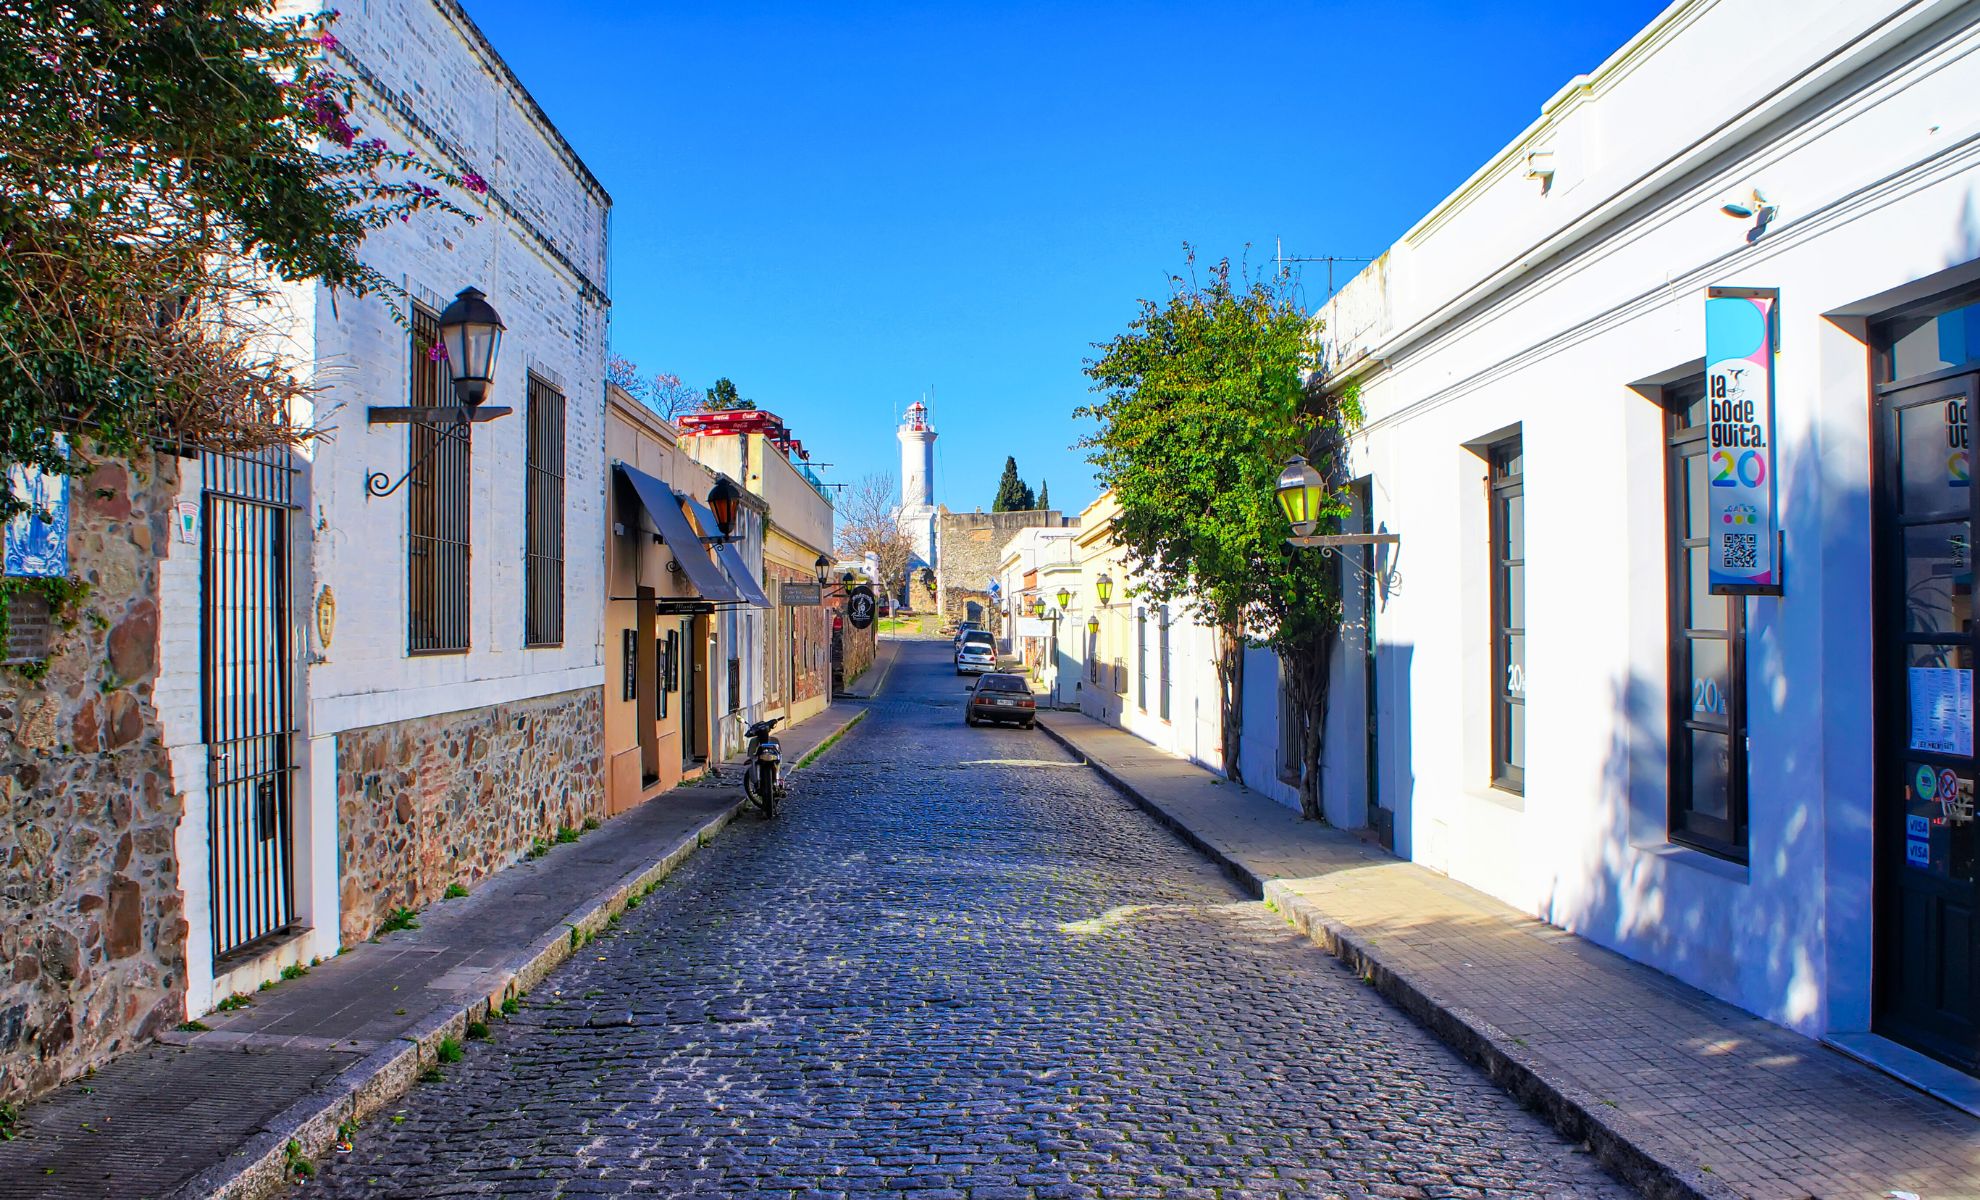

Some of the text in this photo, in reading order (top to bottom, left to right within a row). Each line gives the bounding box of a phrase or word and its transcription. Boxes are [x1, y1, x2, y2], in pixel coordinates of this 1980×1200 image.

[1711, 375, 1726, 398] la
[1712, 450, 1766, 488] 20
[1507, 664, 1522, 691] 20
[1694, 678, 1718, 713] 20
[1910, 819, 1928, 834] VISA
[1910, 845, 1928, 858] VISA
